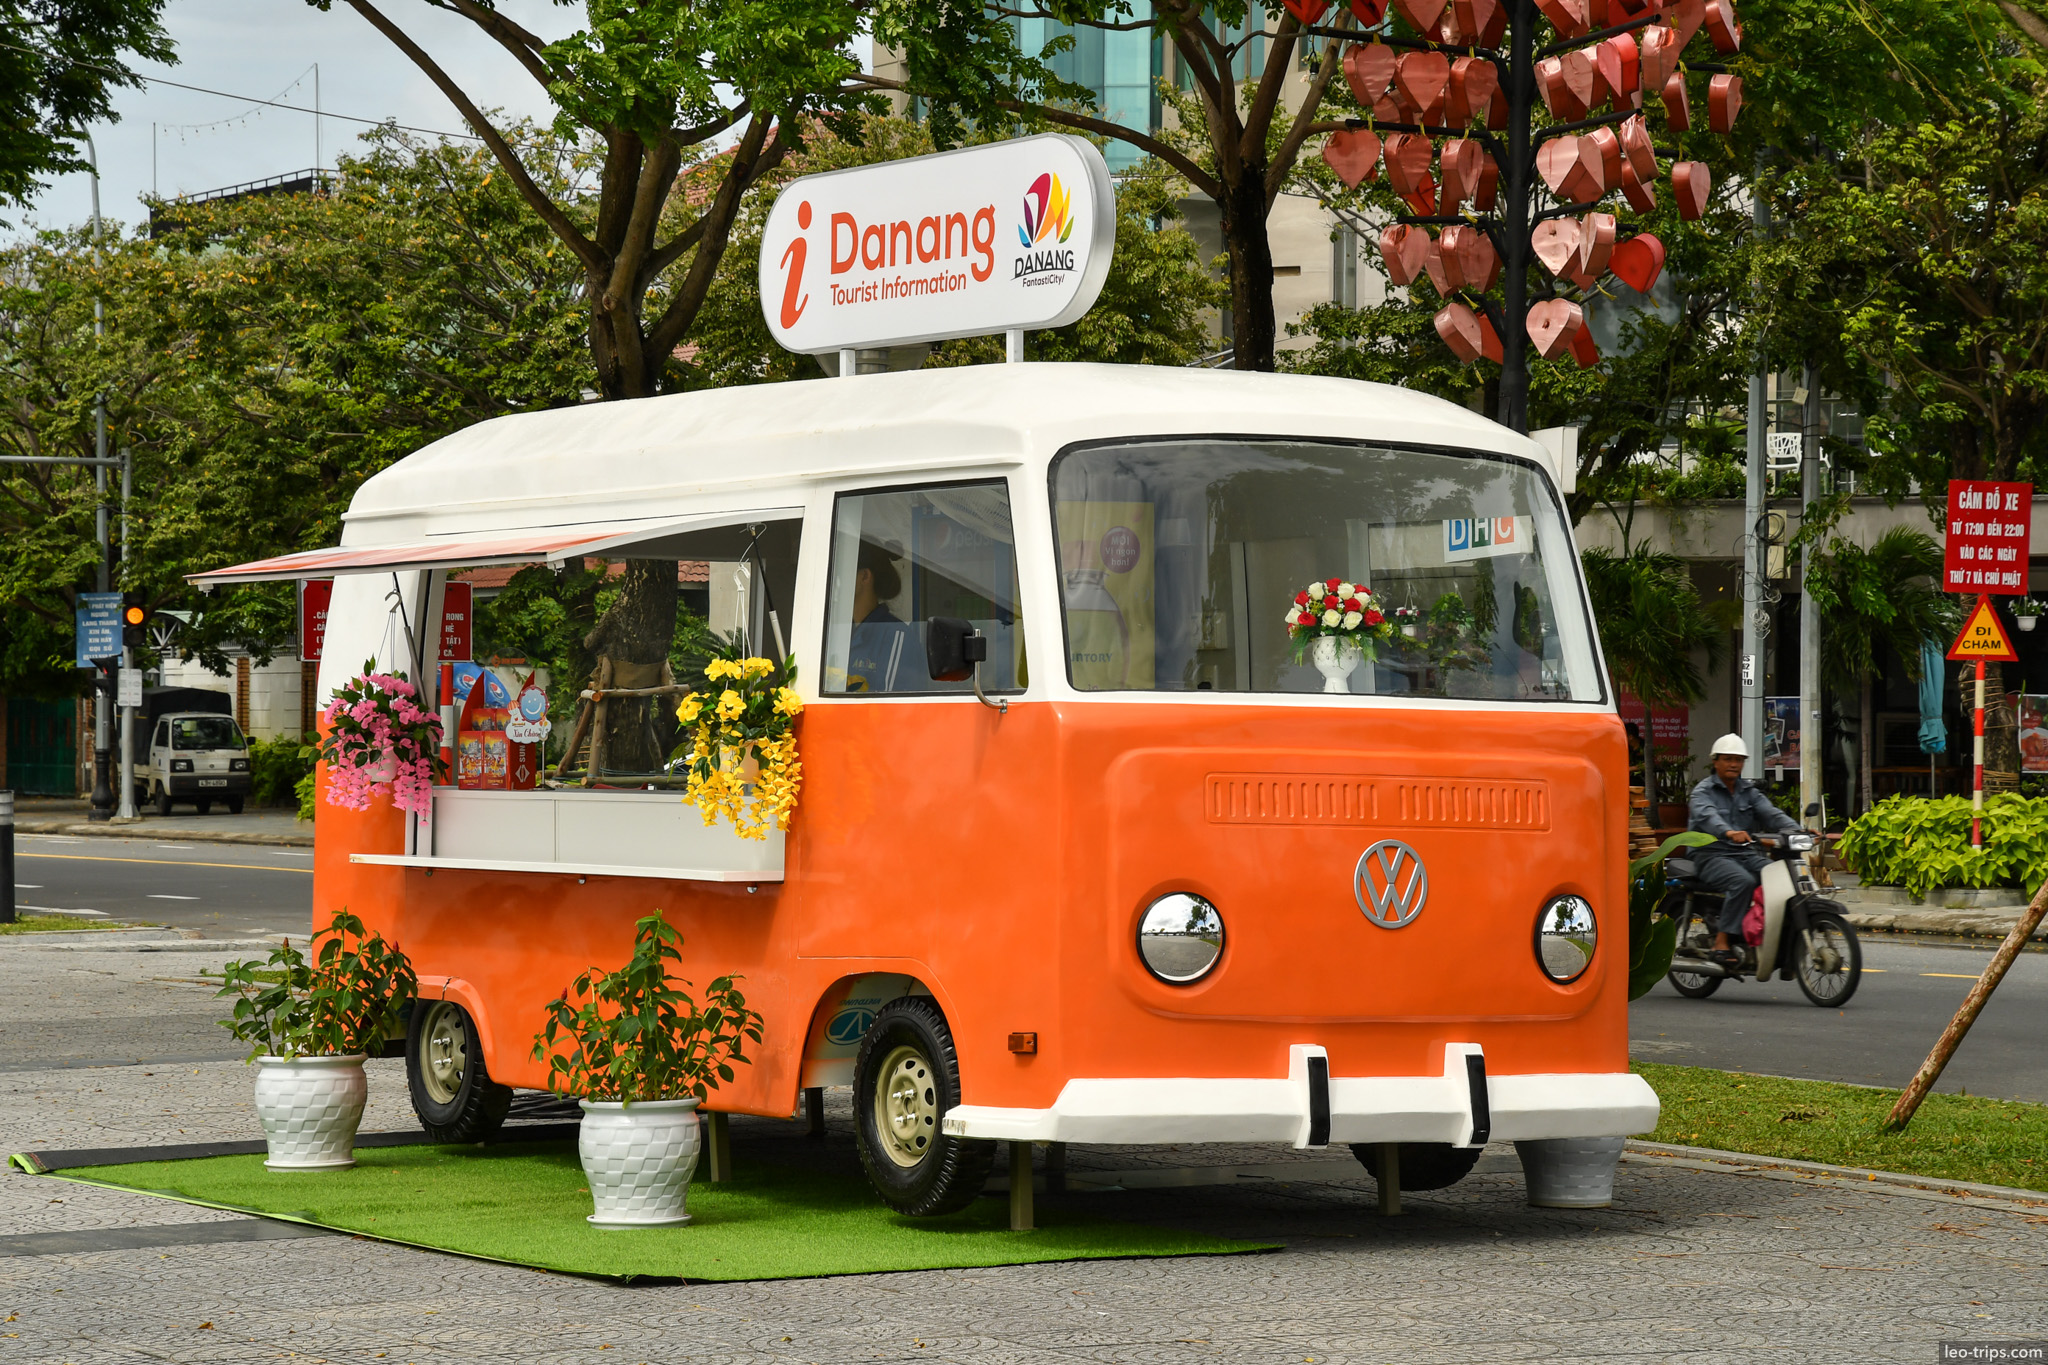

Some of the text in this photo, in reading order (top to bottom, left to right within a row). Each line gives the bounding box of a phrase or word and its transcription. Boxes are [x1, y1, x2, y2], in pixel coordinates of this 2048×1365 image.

[779, 200, 996, 330] i Danang
[1014, 249, 1075, 278] DANANG
[830, 269, 968, 306] Tourist Information
[1959, 484, 1983, 509] CẤM
[2004, 493, 2019, 511] XE
[1965, 522, 1985, 536] 17:00
[1987, 517, 2002, 536] ĐẾN
[2004, 524, 2025, 537] 22:00
[1966, 570, 1972, 584] 7
[445, 613, 464, 621] RONG
[1975, 626, 1991, 636] ĐI
